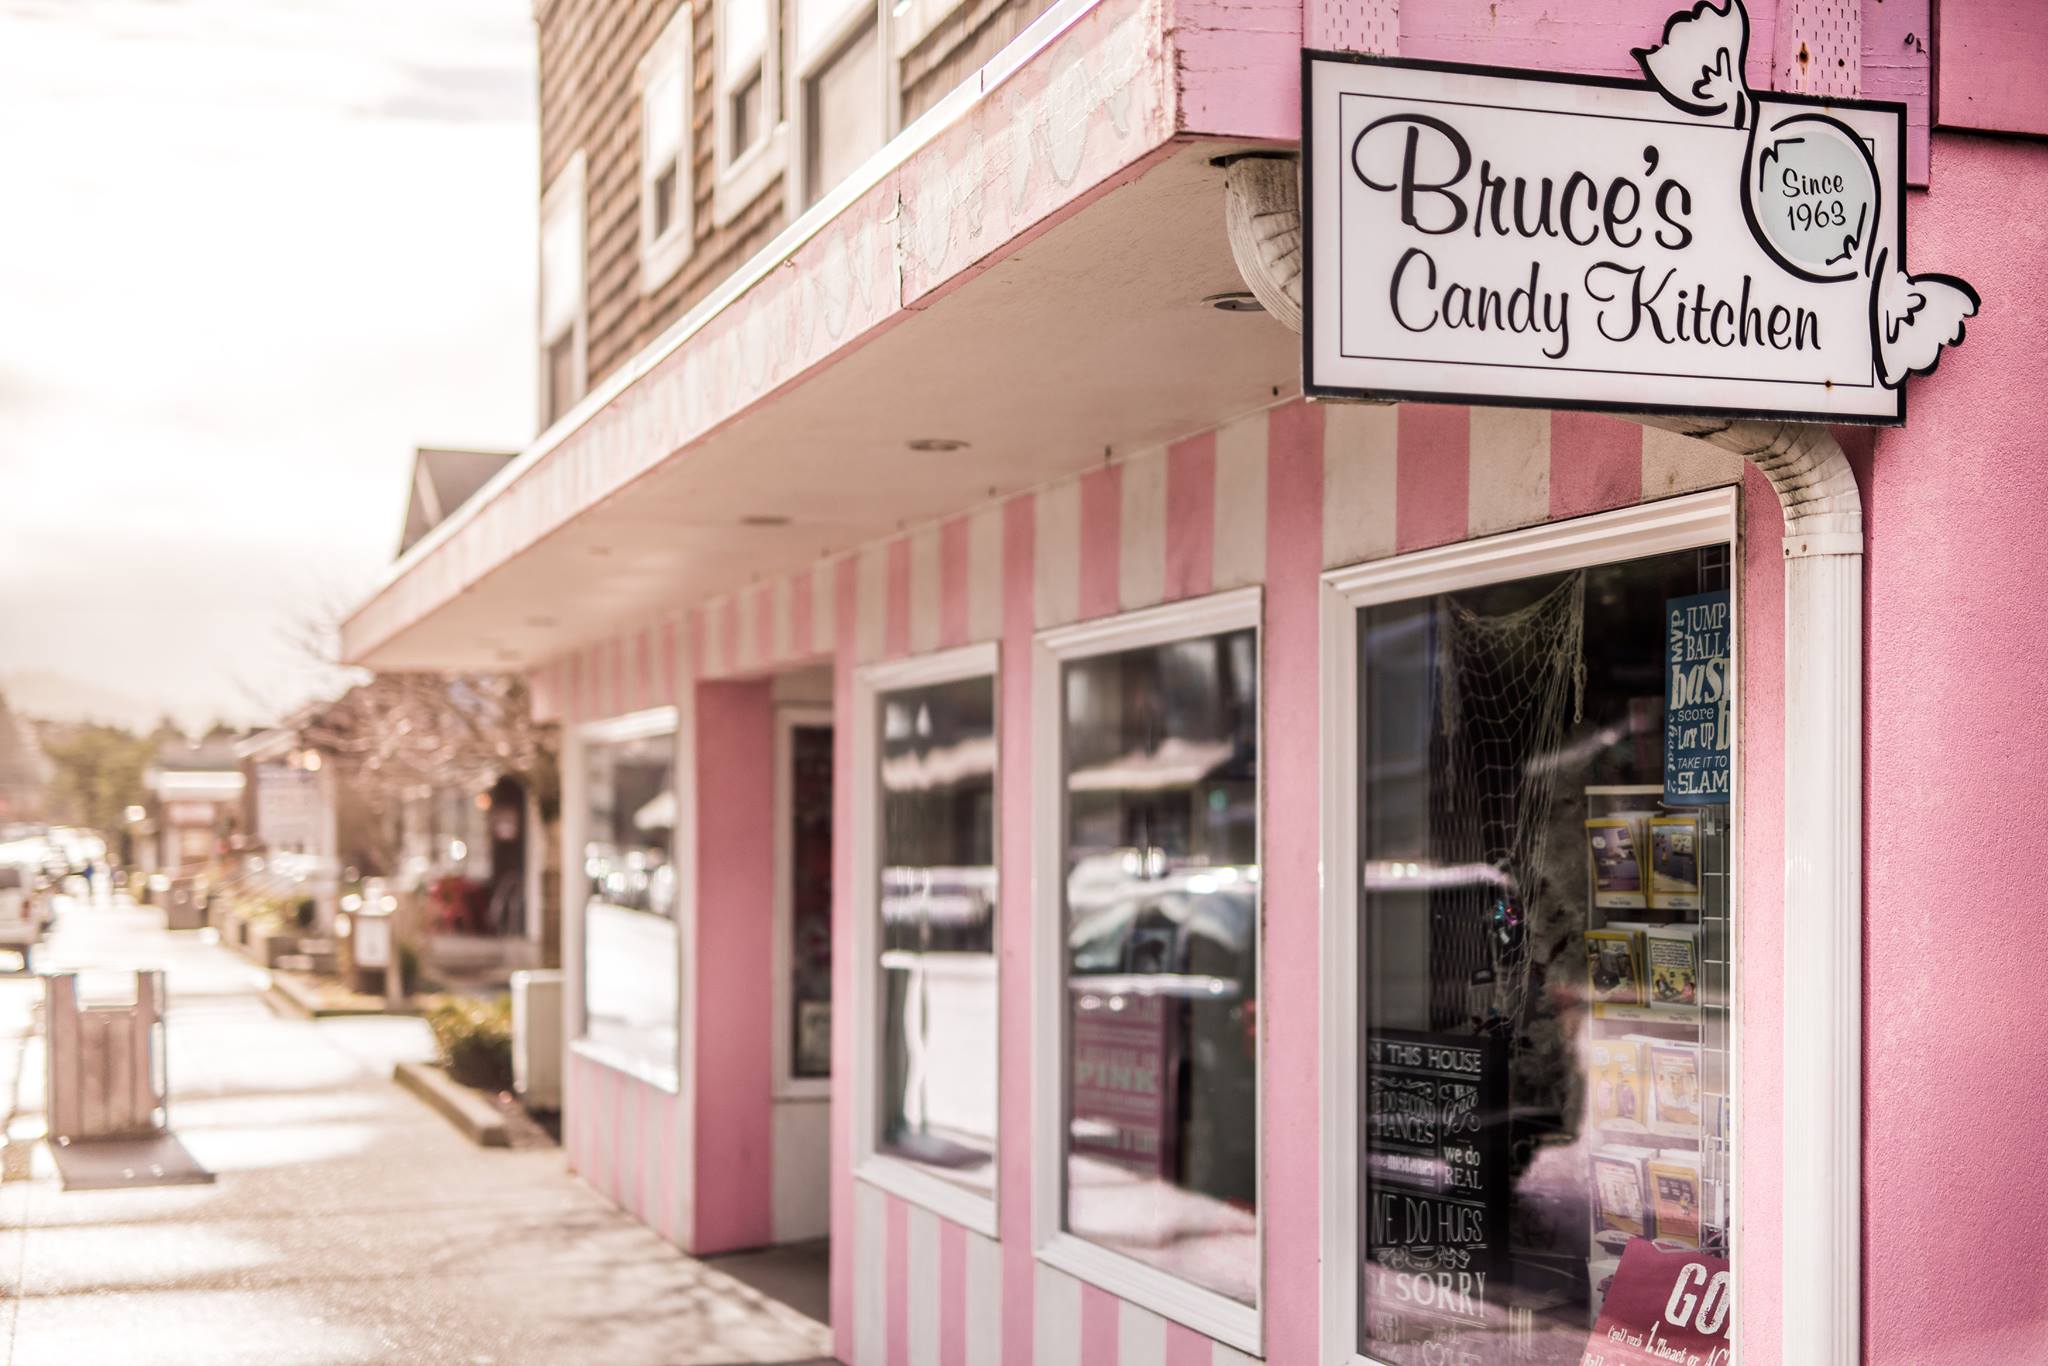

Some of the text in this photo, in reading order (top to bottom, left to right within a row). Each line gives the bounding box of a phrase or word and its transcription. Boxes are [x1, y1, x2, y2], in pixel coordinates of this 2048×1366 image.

[1352, 113, 1695, 250] Bruce's
[1782, 167, 1844, 198] Since
[1787, 200, 1846, 232] 1963
[1390, 247, 1821, 359] Candy Kitchen
[1686, 602, 1727, 634] JUMP
[1671, 609, 1685, 663] MVP
[1684, 632, 1725, 661] BALL
[1677, 707, 1714, 721] score
[1700, 722, 1715, 750] UP
[1677, 755, 1728, 769] TAKE IT TO
[1677, 769, 1729, 795] SLAM
[1387, 1044, 1422, 1067] THIS
[1428, 1048, 1483, 1073] HOUSE
[1443, 1144, 1481, 1167] we do
[1444, 1165, 1483, 1190] REAL
[1405, 1197, 1432, 1245] DO
[1438, 1203, 1484, 1243] HUGS
[1395, 1272, 1486, 1318] SORRY
[1664, 1262, 1730, 1338] GO
